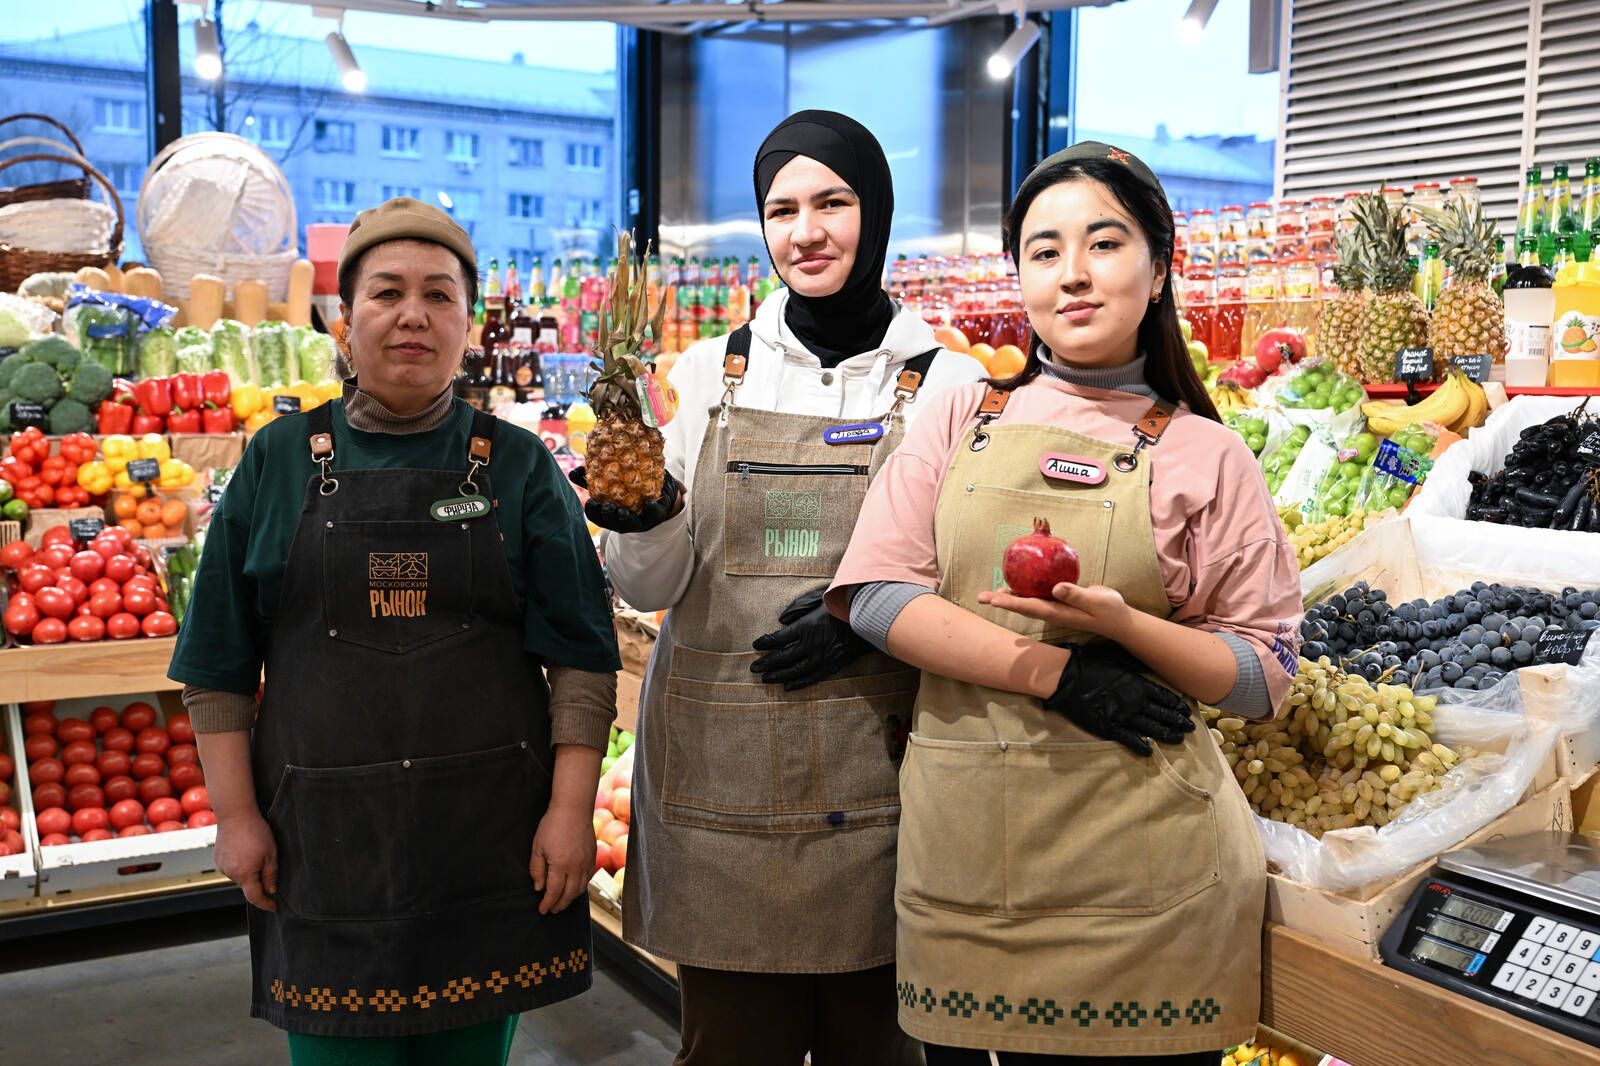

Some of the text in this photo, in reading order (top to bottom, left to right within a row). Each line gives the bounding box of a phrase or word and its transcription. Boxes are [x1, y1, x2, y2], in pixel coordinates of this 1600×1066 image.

[444, 502, 480, 517] ФИРУЗА
[764, 528, 820, 557] РЫНОК
[369, 589, 427, 618] РЫНОК
[1534, 924, 1592, 951] 7 8 9
[1519, 948, 1577, 974] 4 5 6
[1505, 971, 1585, 1007] 1 2 3 0
